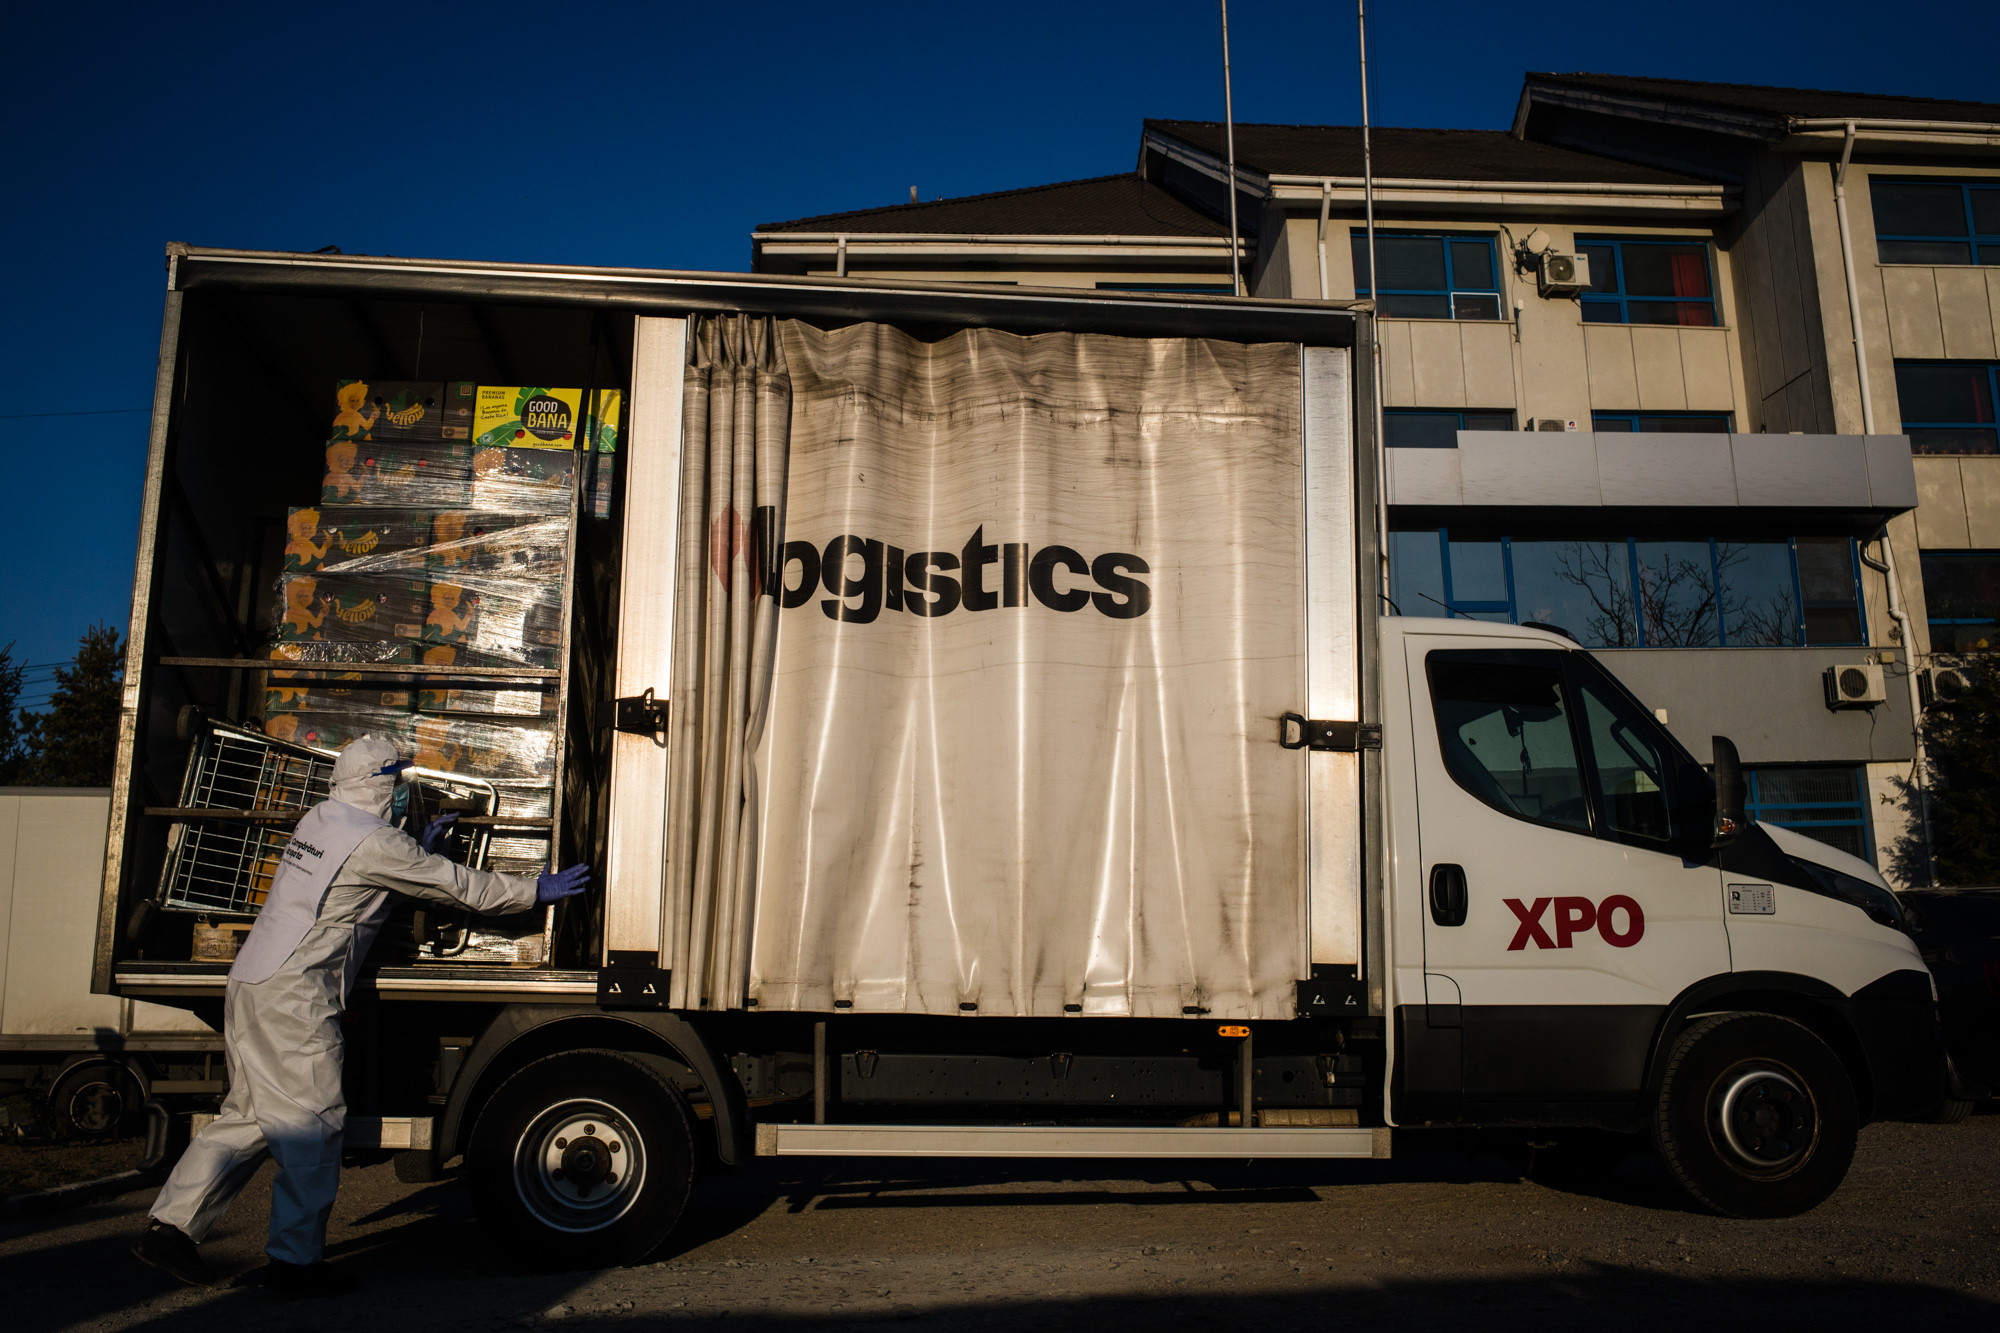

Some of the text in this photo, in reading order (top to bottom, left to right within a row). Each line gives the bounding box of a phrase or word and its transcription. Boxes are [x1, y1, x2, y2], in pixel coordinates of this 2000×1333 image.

[385, 402, 425, 426] yellow
[528, 401, 558, 413] GOOD
[527, 413, 567, 429] BANA
[337, 530, 379, 554] yellow
[334, 598, 376, 623] yellow
[1502, 894, 1645, 951] XPO
